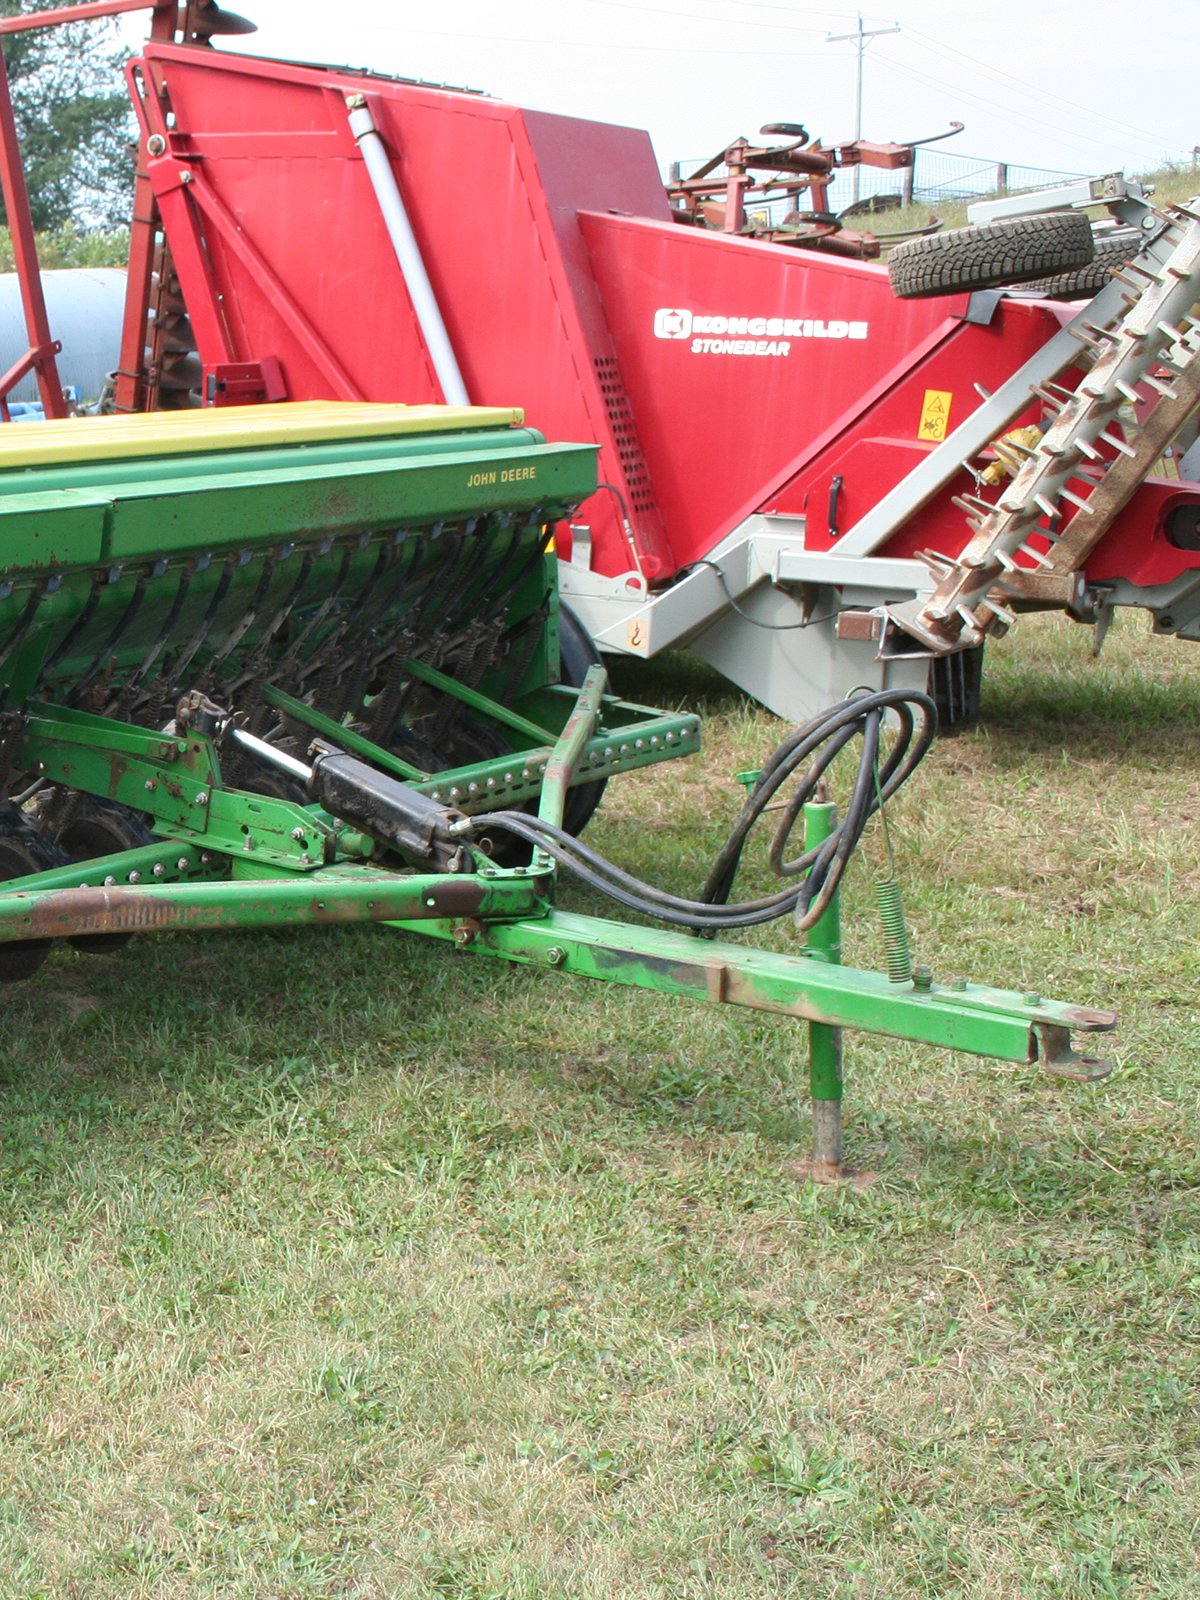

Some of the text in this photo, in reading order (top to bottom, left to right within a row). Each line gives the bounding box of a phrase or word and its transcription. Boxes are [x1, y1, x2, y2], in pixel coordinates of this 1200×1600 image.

[692, 316, 869, 340] KONGSKILDE
[690, 339, 791, 357] STONEBEAR
[467, 466, 536, 487] JOHN DEERE
